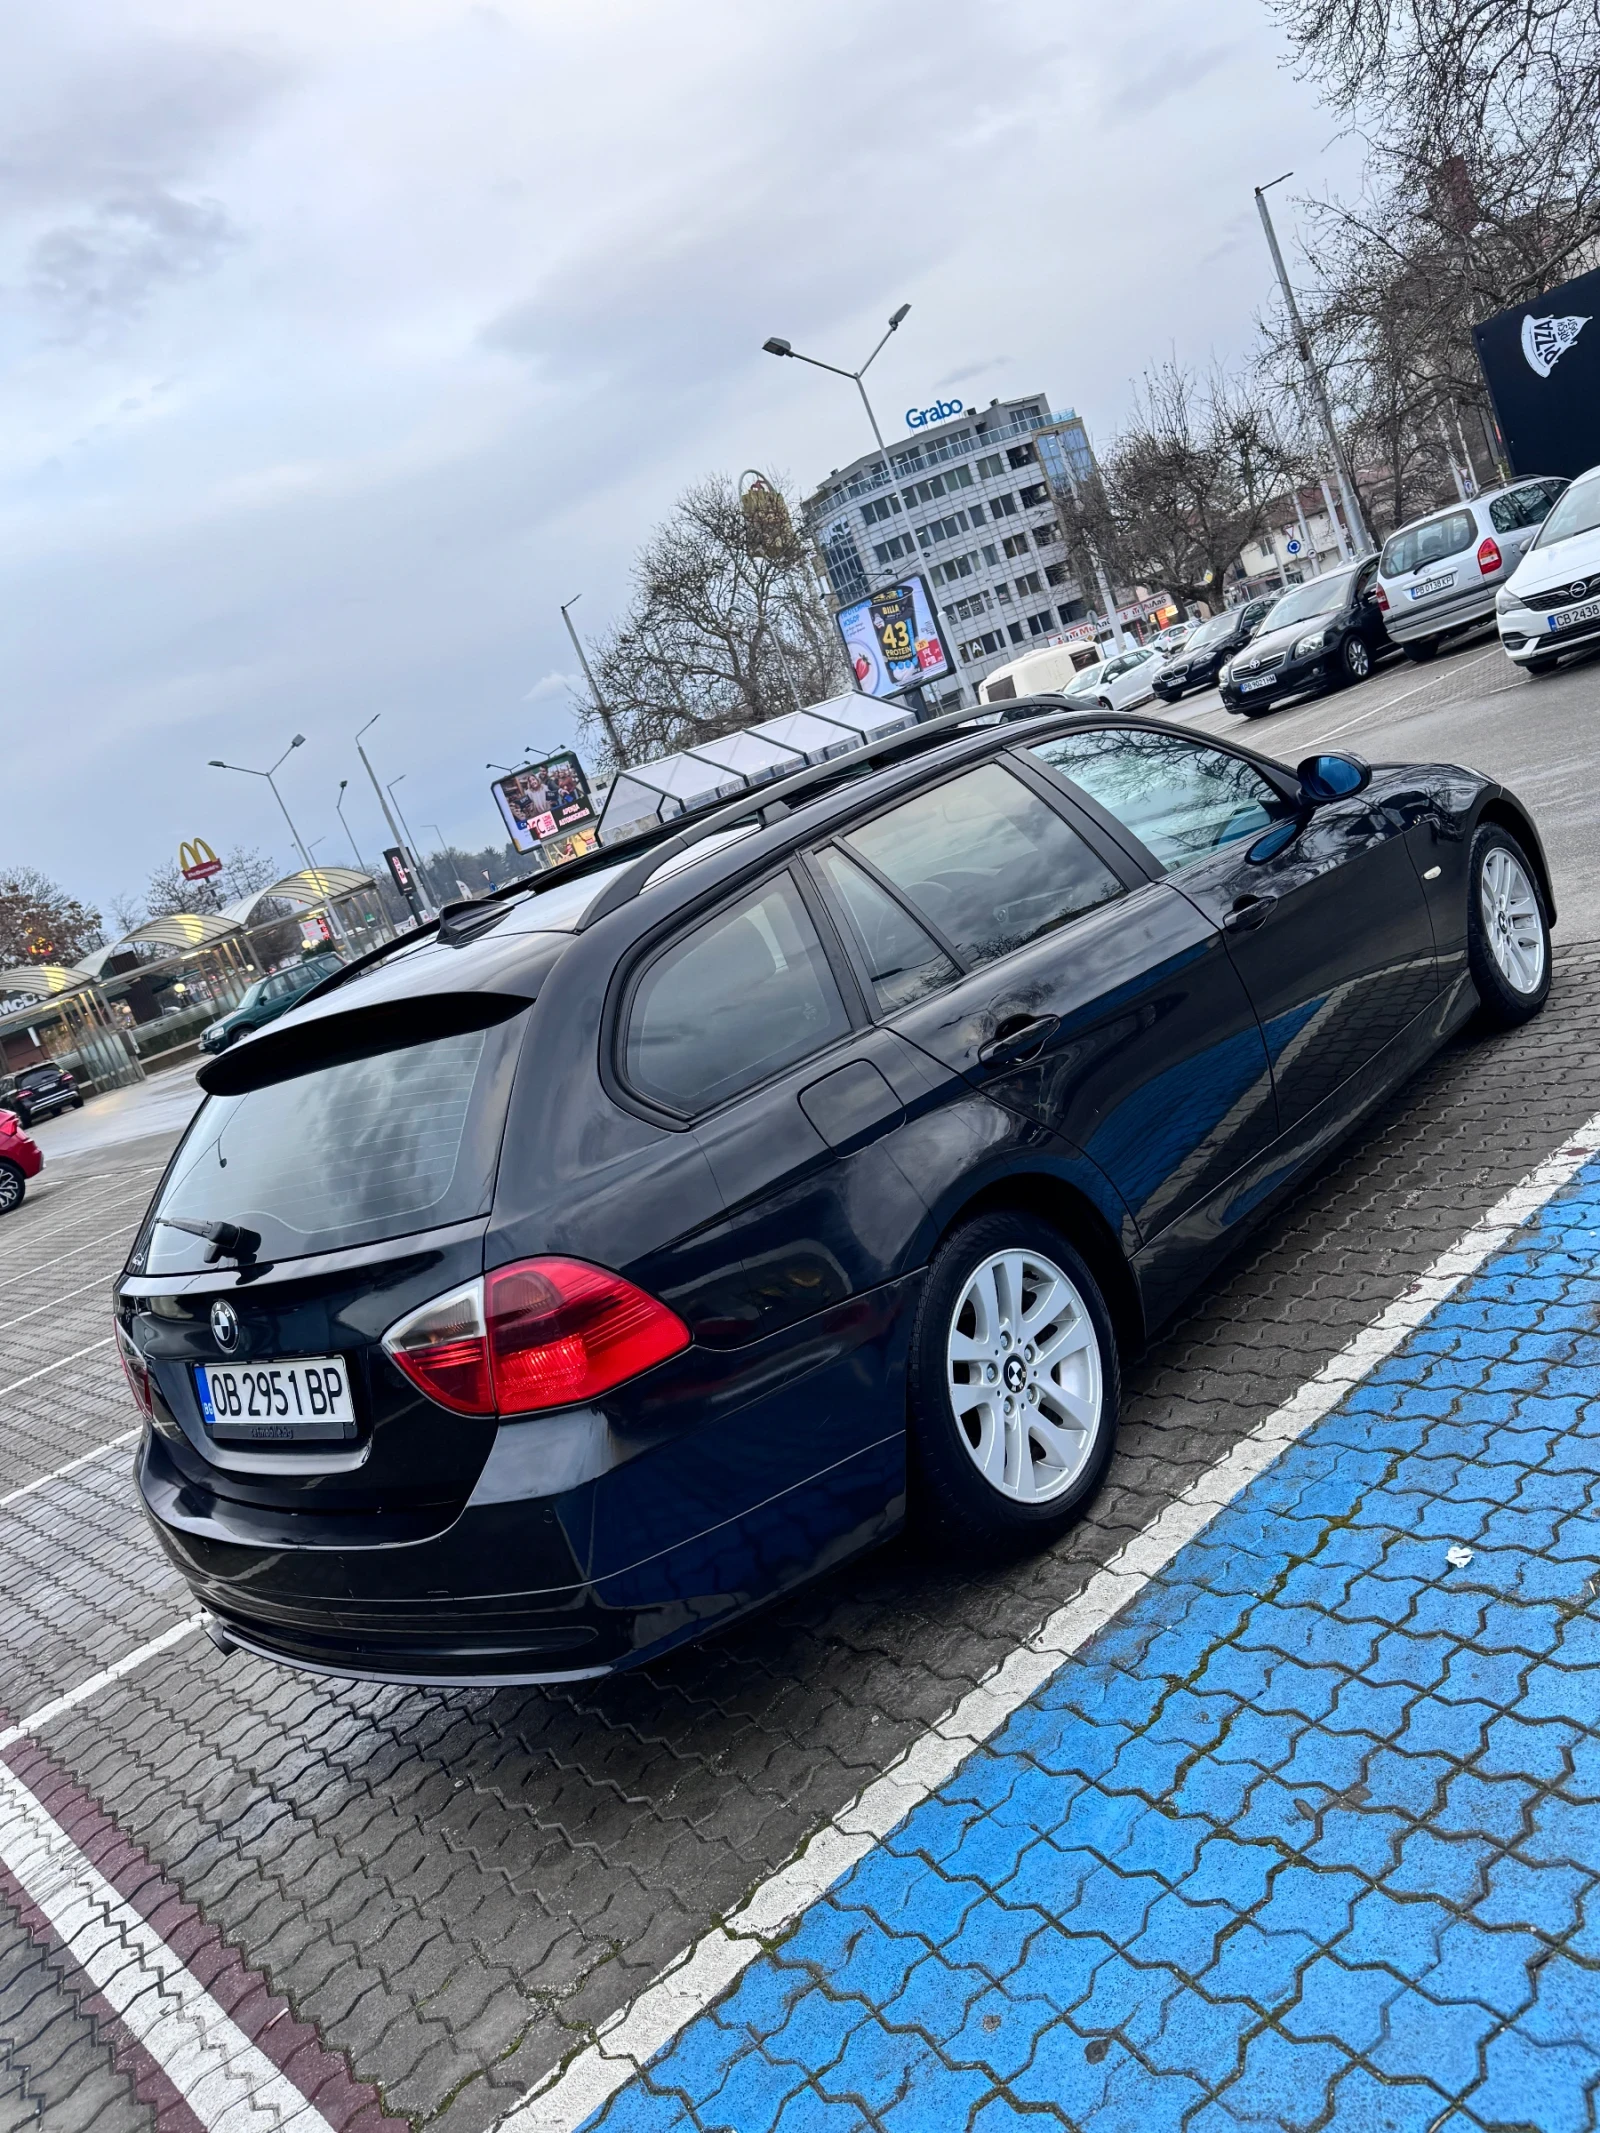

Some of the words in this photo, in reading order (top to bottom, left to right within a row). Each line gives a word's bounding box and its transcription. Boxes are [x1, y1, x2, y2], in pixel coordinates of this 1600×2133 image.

[905, 399, 963, 428] Grabo
[882, 604, 900, 615] BILLA
[1556, 613, 1572, 626] CB
[1572, 604, 1599, 621] 2438
[883, 621, 909, 648] 43
[885, 646, 912, 657] PROTEIN
[211, 1373, 241, 1416] OB
[242, 1370, 303, 1416] 2951
[304, 1367, 342, 1415] BP
[203, 1402, 214, 1415] BG
